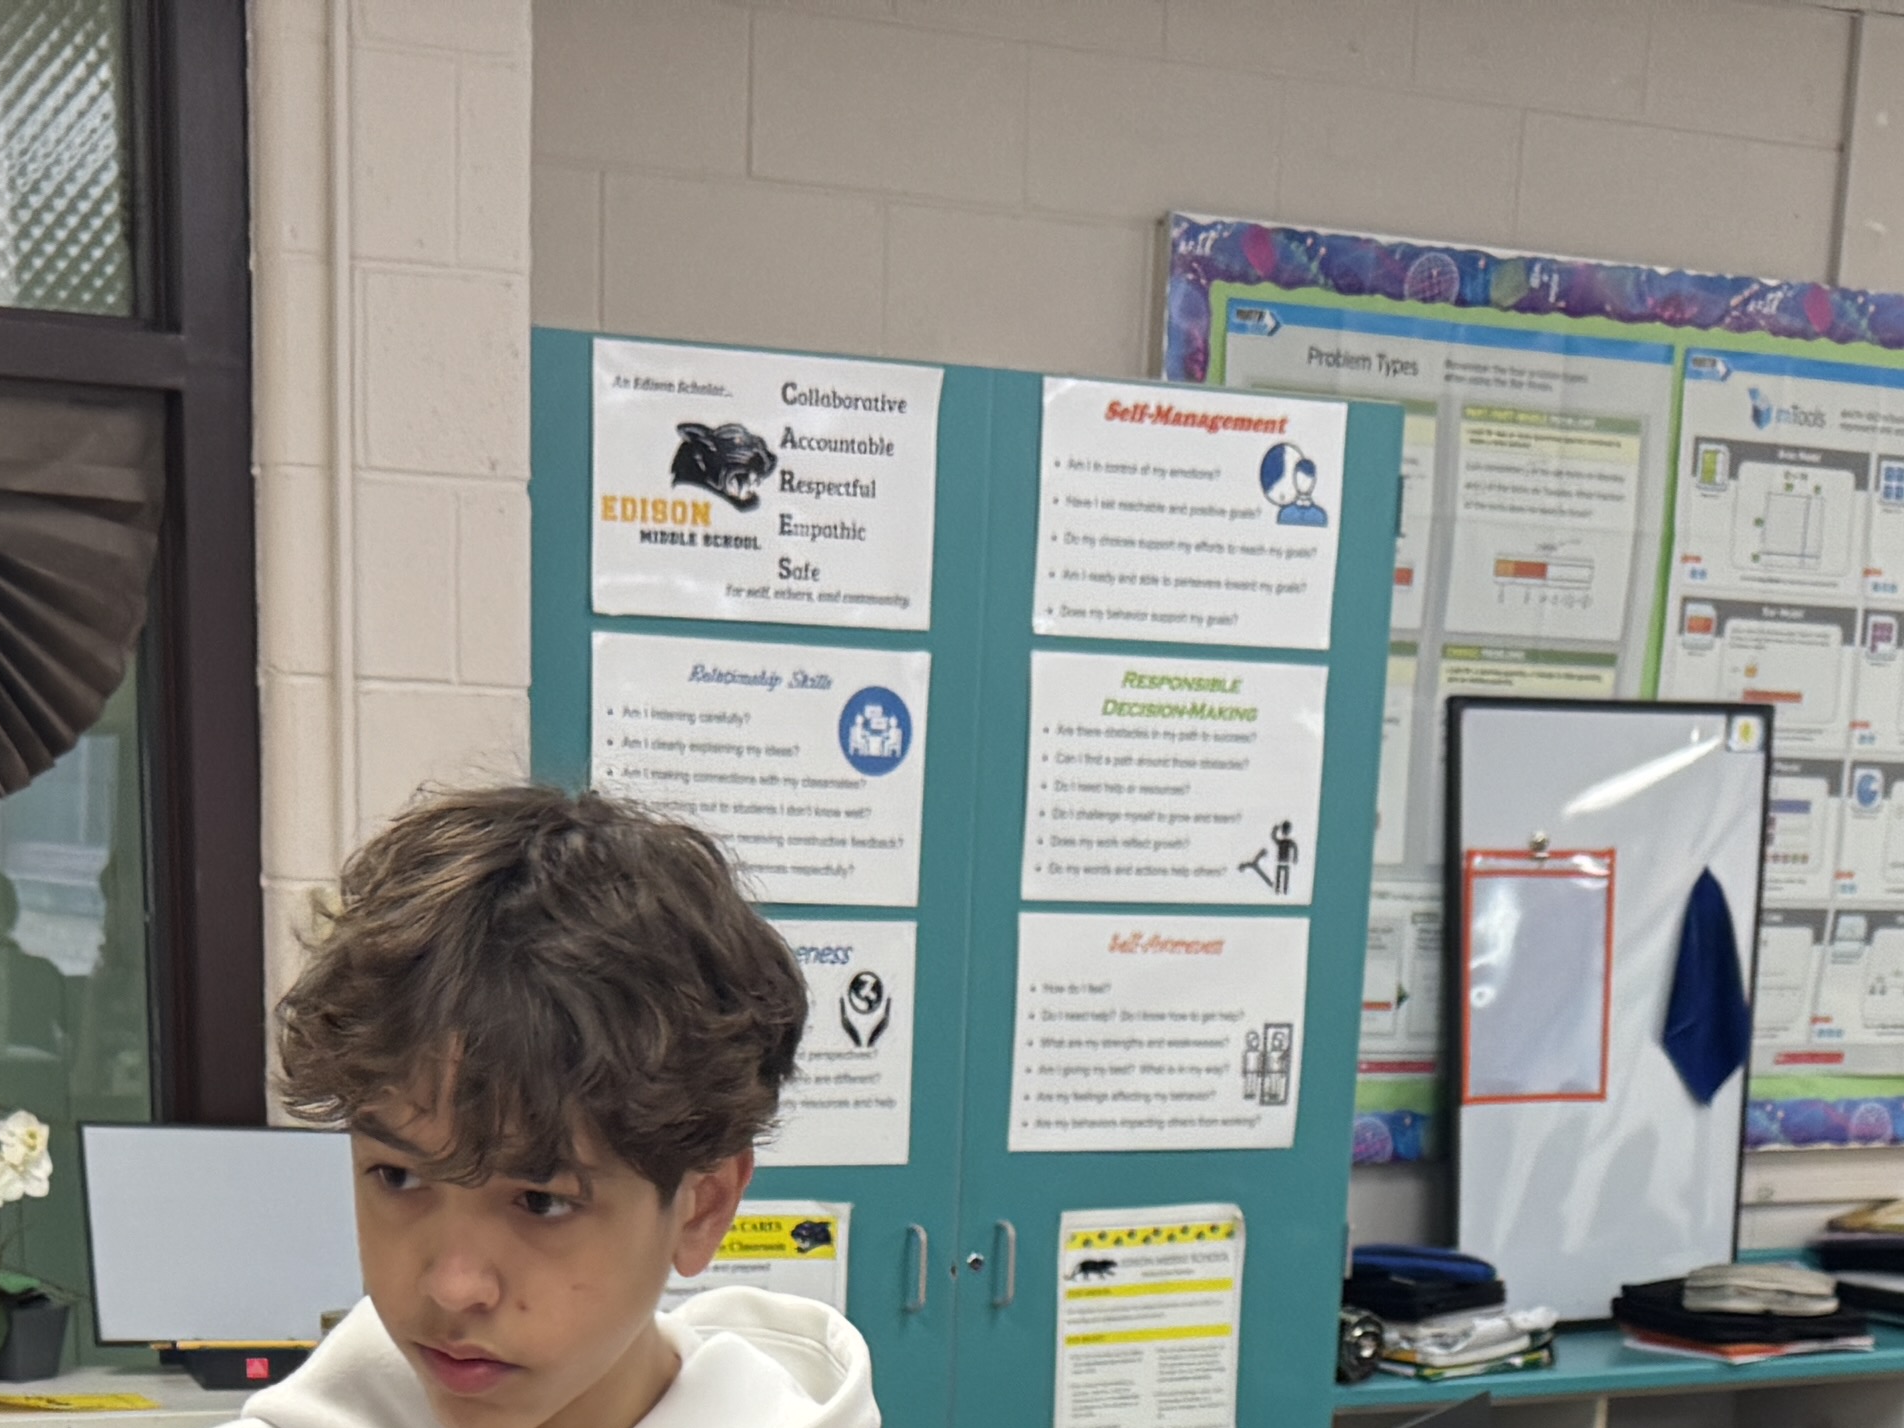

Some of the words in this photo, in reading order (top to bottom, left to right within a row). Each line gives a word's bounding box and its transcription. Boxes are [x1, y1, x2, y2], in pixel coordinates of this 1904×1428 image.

[1307, 345, 1372, 374] Problem
[1376, 352, 1419, 379] Types
[633, 376, 675, 393] Edison
[781, 381, 907, 414] Collaborative
[1104, 399, 1289, 434] Self-Management
[1775, 405, 1826, 428] mTools
[780, 426, 895, 456] Accountable
[779, 469, 876, 500] Respectful
[601, 495, 711, 526] EDISON
[639, 529, 697, 547] MIDDLE
[703, 532, 761, 550] SCHOOL
[779, 513, 866, 542] Empathic
[778, 557, 820, 582] Safe
[726, 584, 744, 597] for
[818, 590, 840, 603] and
[688, 664, 783, 692] Relationship
[788, 669, 833, 691] Skills
[853, 1098, 872, 1108] and
[874, 1097, 897, 1111] help
[740, 1222, 783, 1233] CARES
